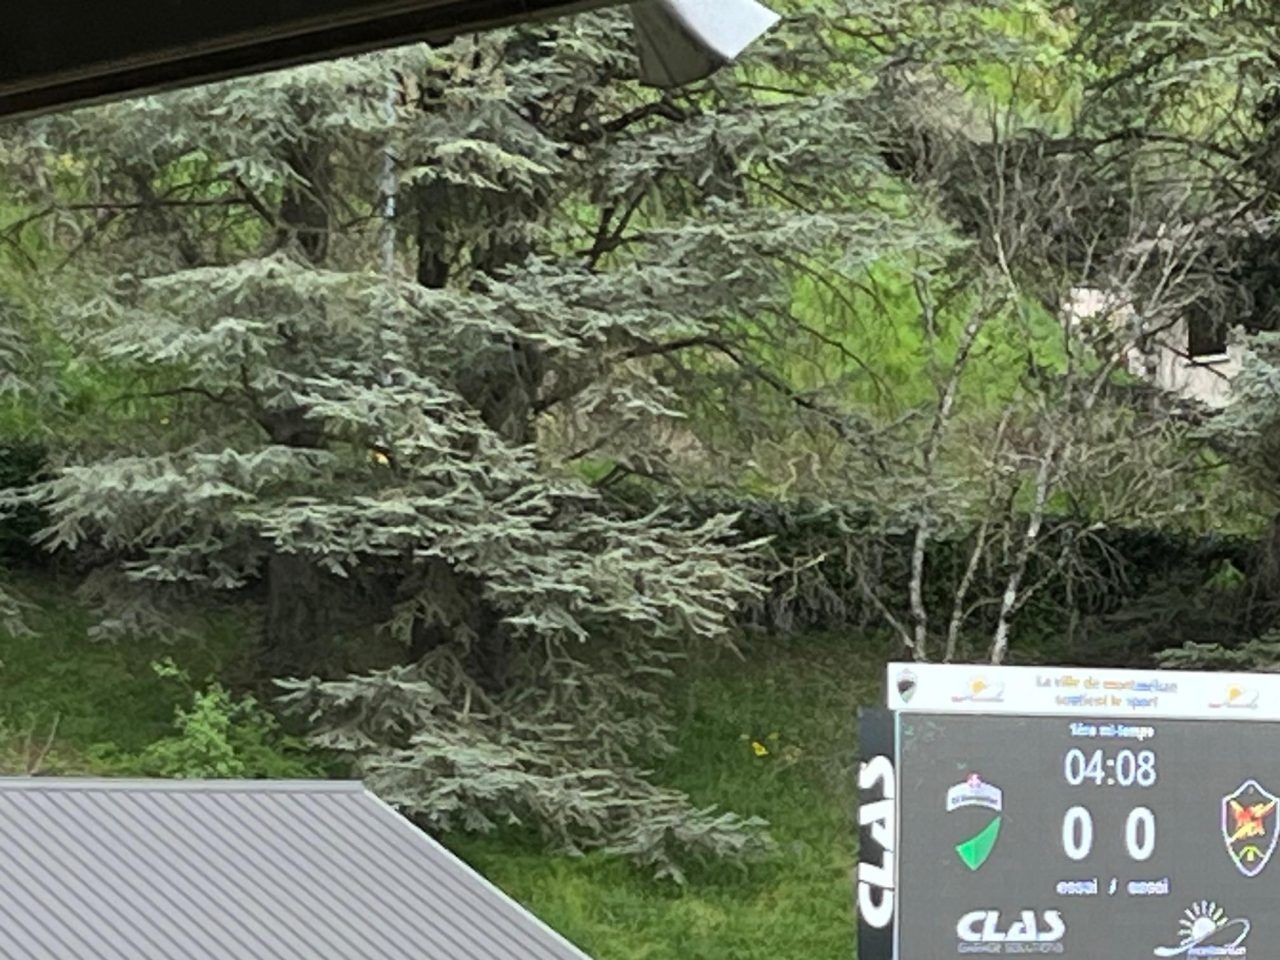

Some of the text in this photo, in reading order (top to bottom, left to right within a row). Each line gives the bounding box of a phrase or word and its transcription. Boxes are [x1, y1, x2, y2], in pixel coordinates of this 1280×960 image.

[1064, 747, 1157, 786] 04:08
[858, 755, 895, 928] CLAS
[1062, 805, 1156, 861] 0 0
[956, 910, 1066, 941] CLAS
